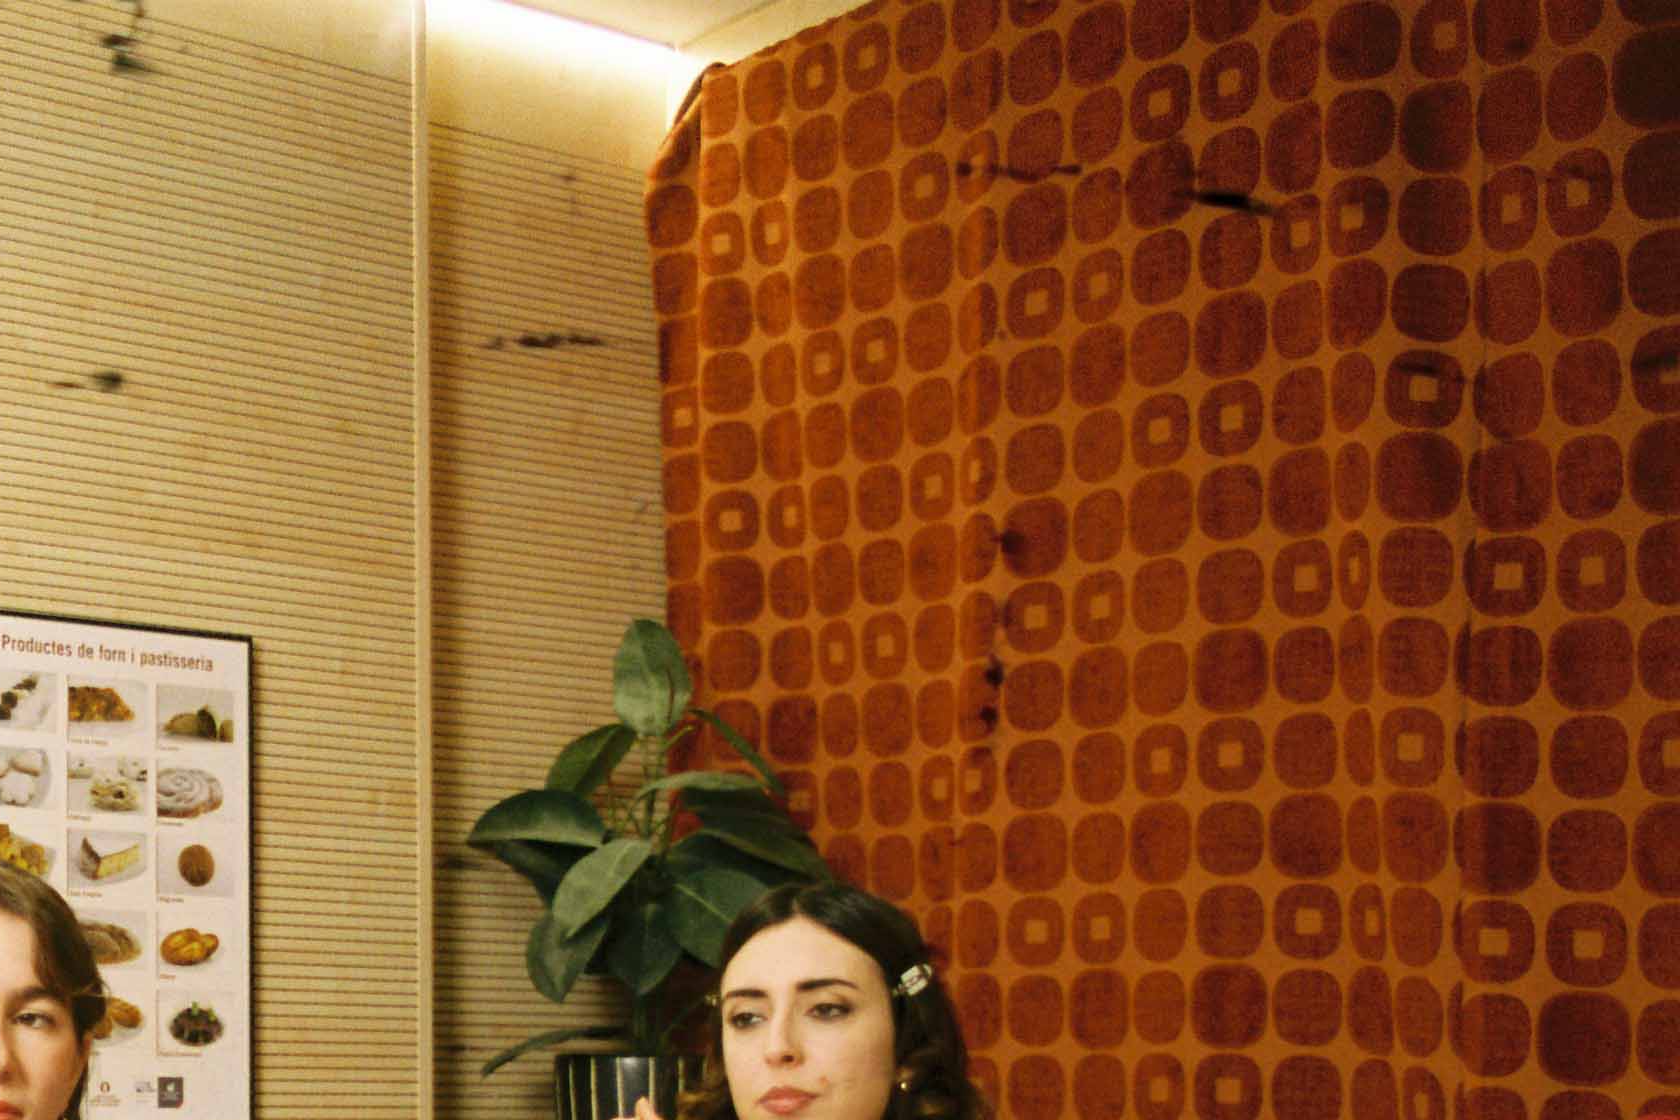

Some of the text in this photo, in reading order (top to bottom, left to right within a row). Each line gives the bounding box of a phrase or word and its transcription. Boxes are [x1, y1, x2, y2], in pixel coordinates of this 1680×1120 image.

[1, 634, 72, 657] Productes
[77, 642, 94, 659] de
[99, 645, 126, 663] forn
[140, 650, 214, 672] pastisseria
